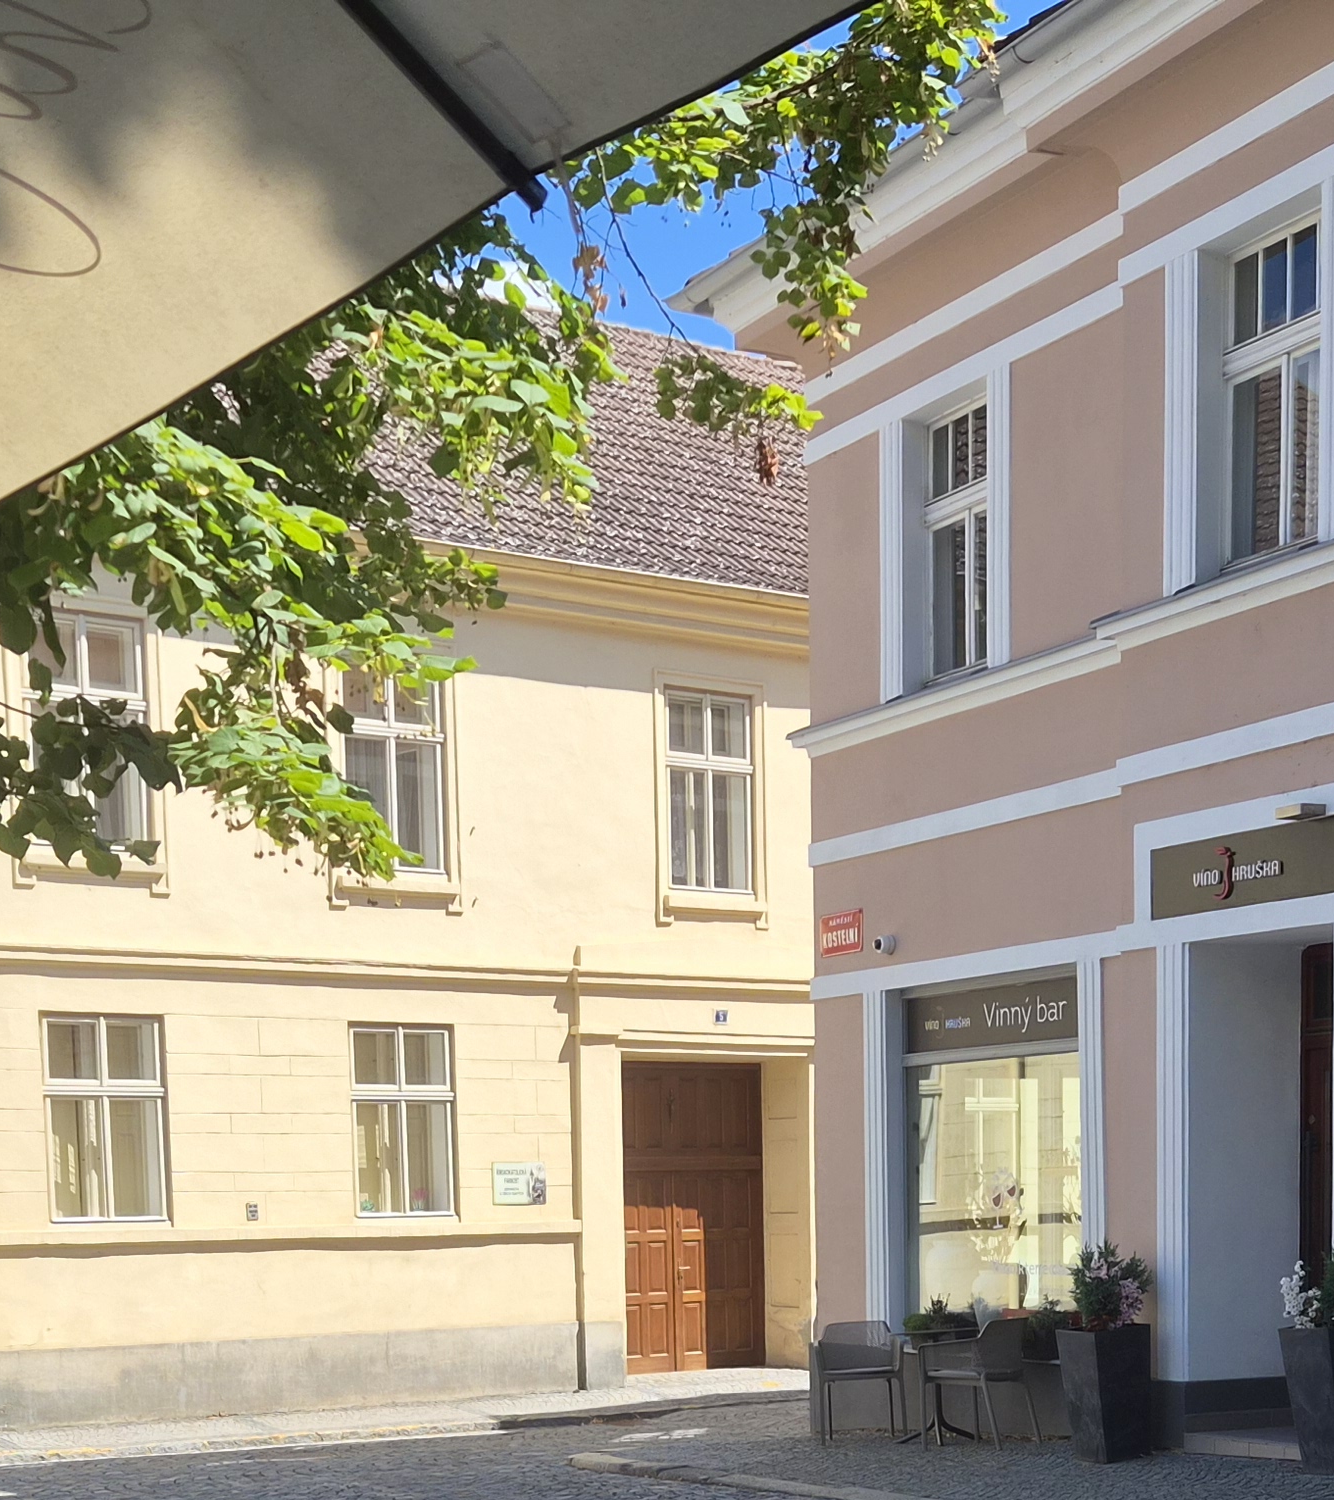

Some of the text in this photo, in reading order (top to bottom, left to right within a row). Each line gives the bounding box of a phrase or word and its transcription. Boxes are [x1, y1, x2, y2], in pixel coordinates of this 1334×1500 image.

[1192, 860, 1280, 887] VÍNO HRUŠKA
[822, 923, 859, 949] KOSTELNÍ
[982, 995, 1068, 1033] Vinný bar
